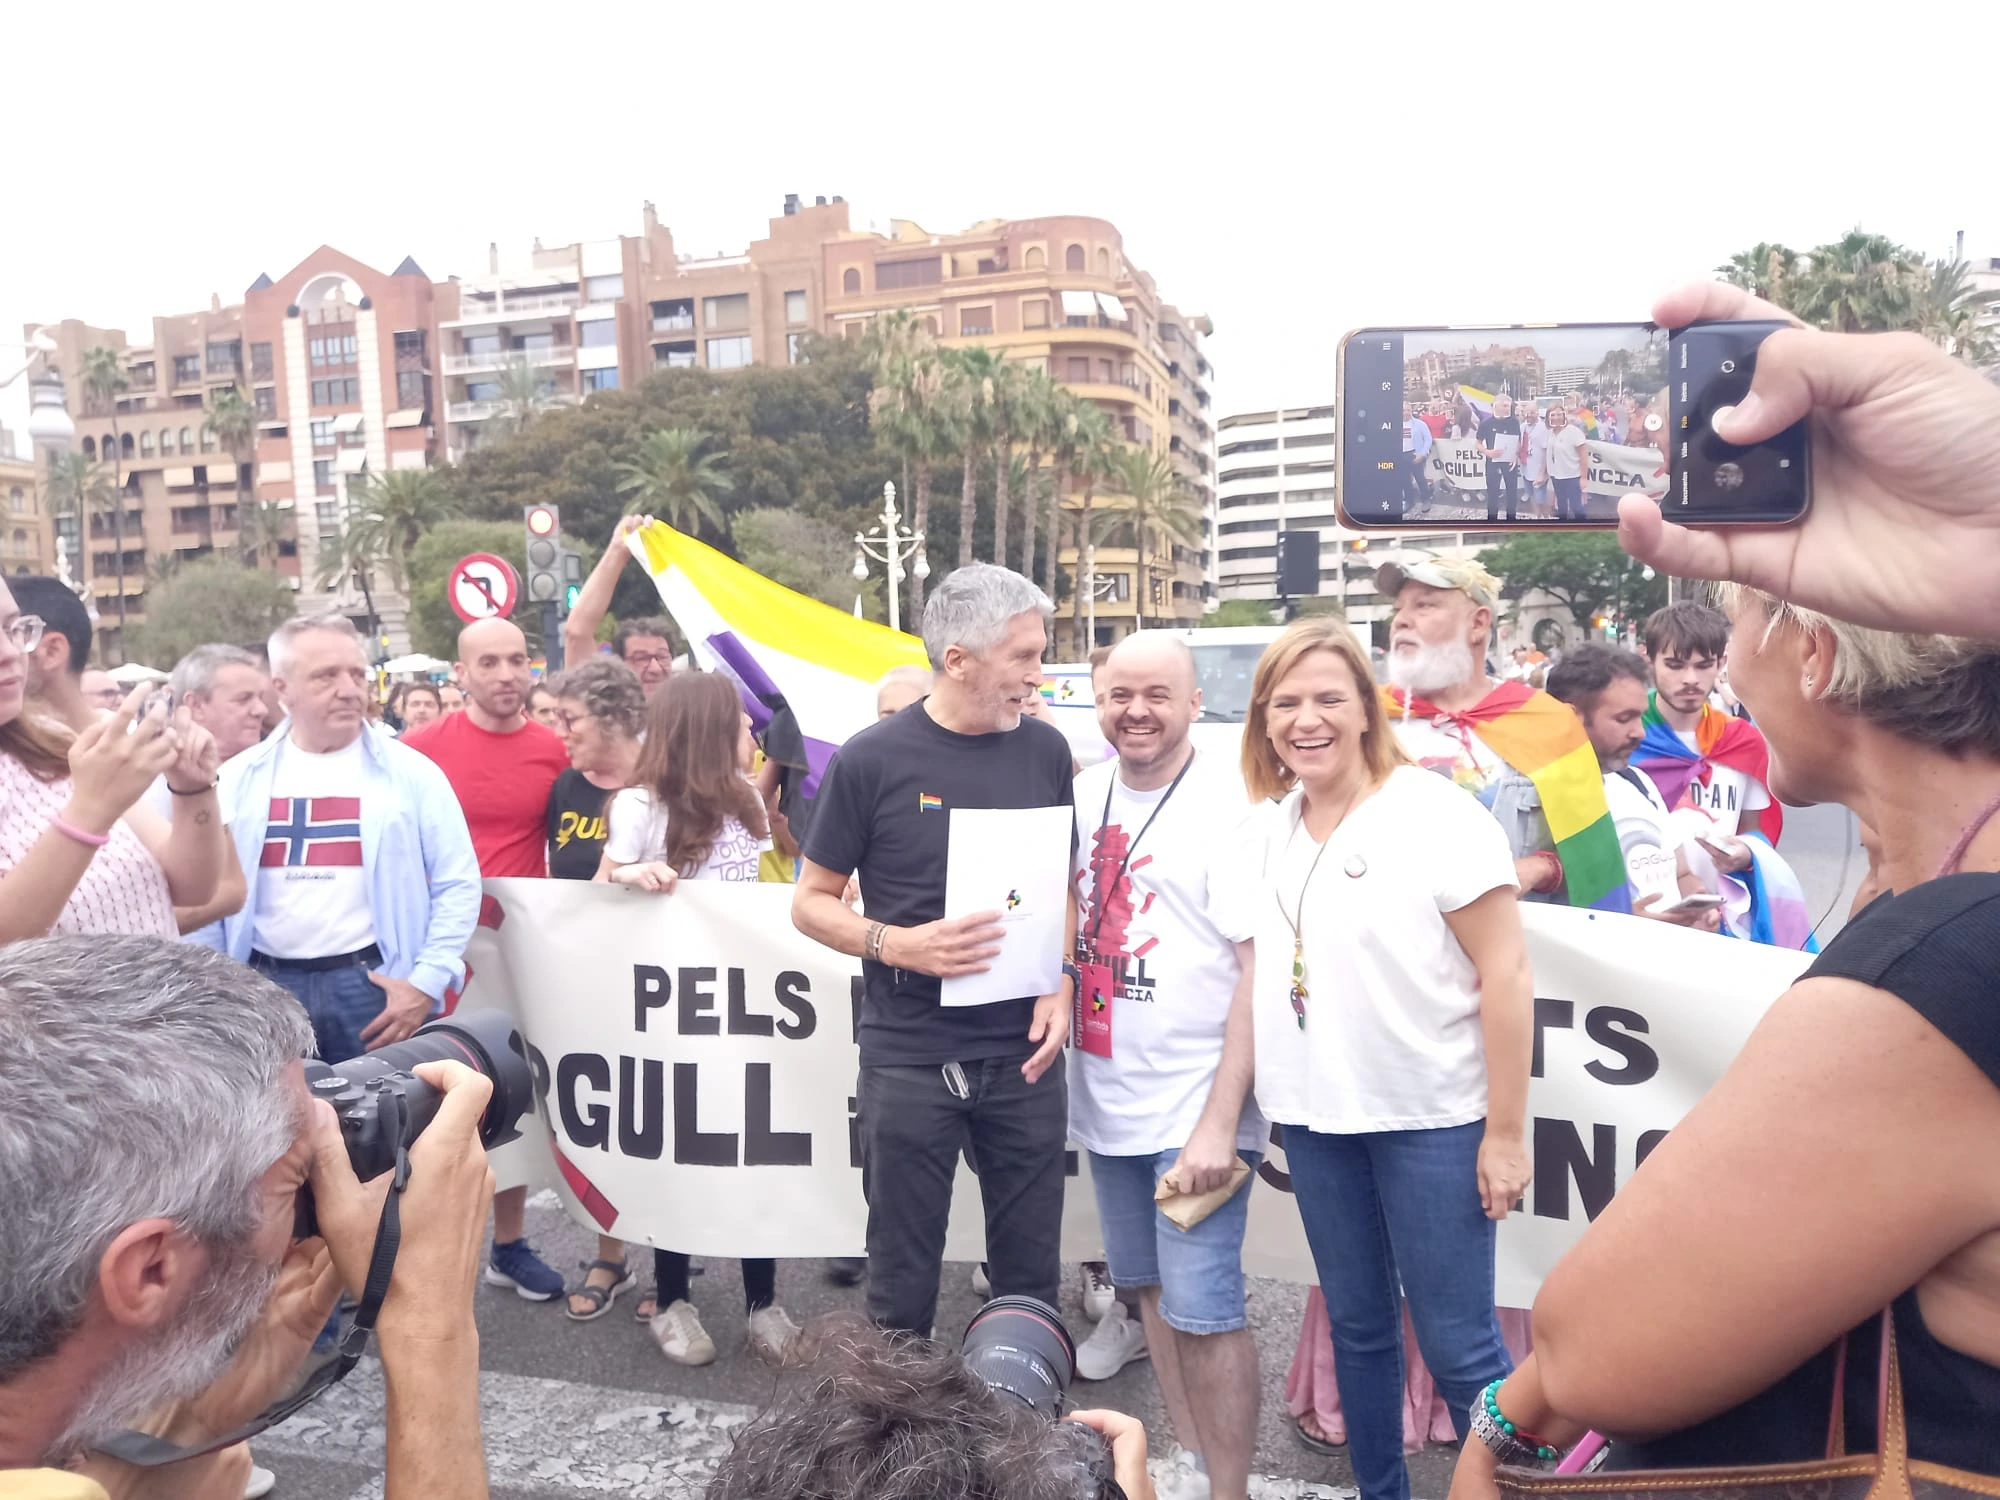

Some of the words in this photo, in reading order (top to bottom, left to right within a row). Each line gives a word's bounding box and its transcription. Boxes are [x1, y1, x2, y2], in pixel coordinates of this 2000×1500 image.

[1381, 422, 1392, 430] AI
[1456, 449, 1484, 460] PELS
[1377, 462, 1394, 470] HDR
[1433, 458, 1484, 478] OGULL
[633, 964, 817, 1040] PELS
